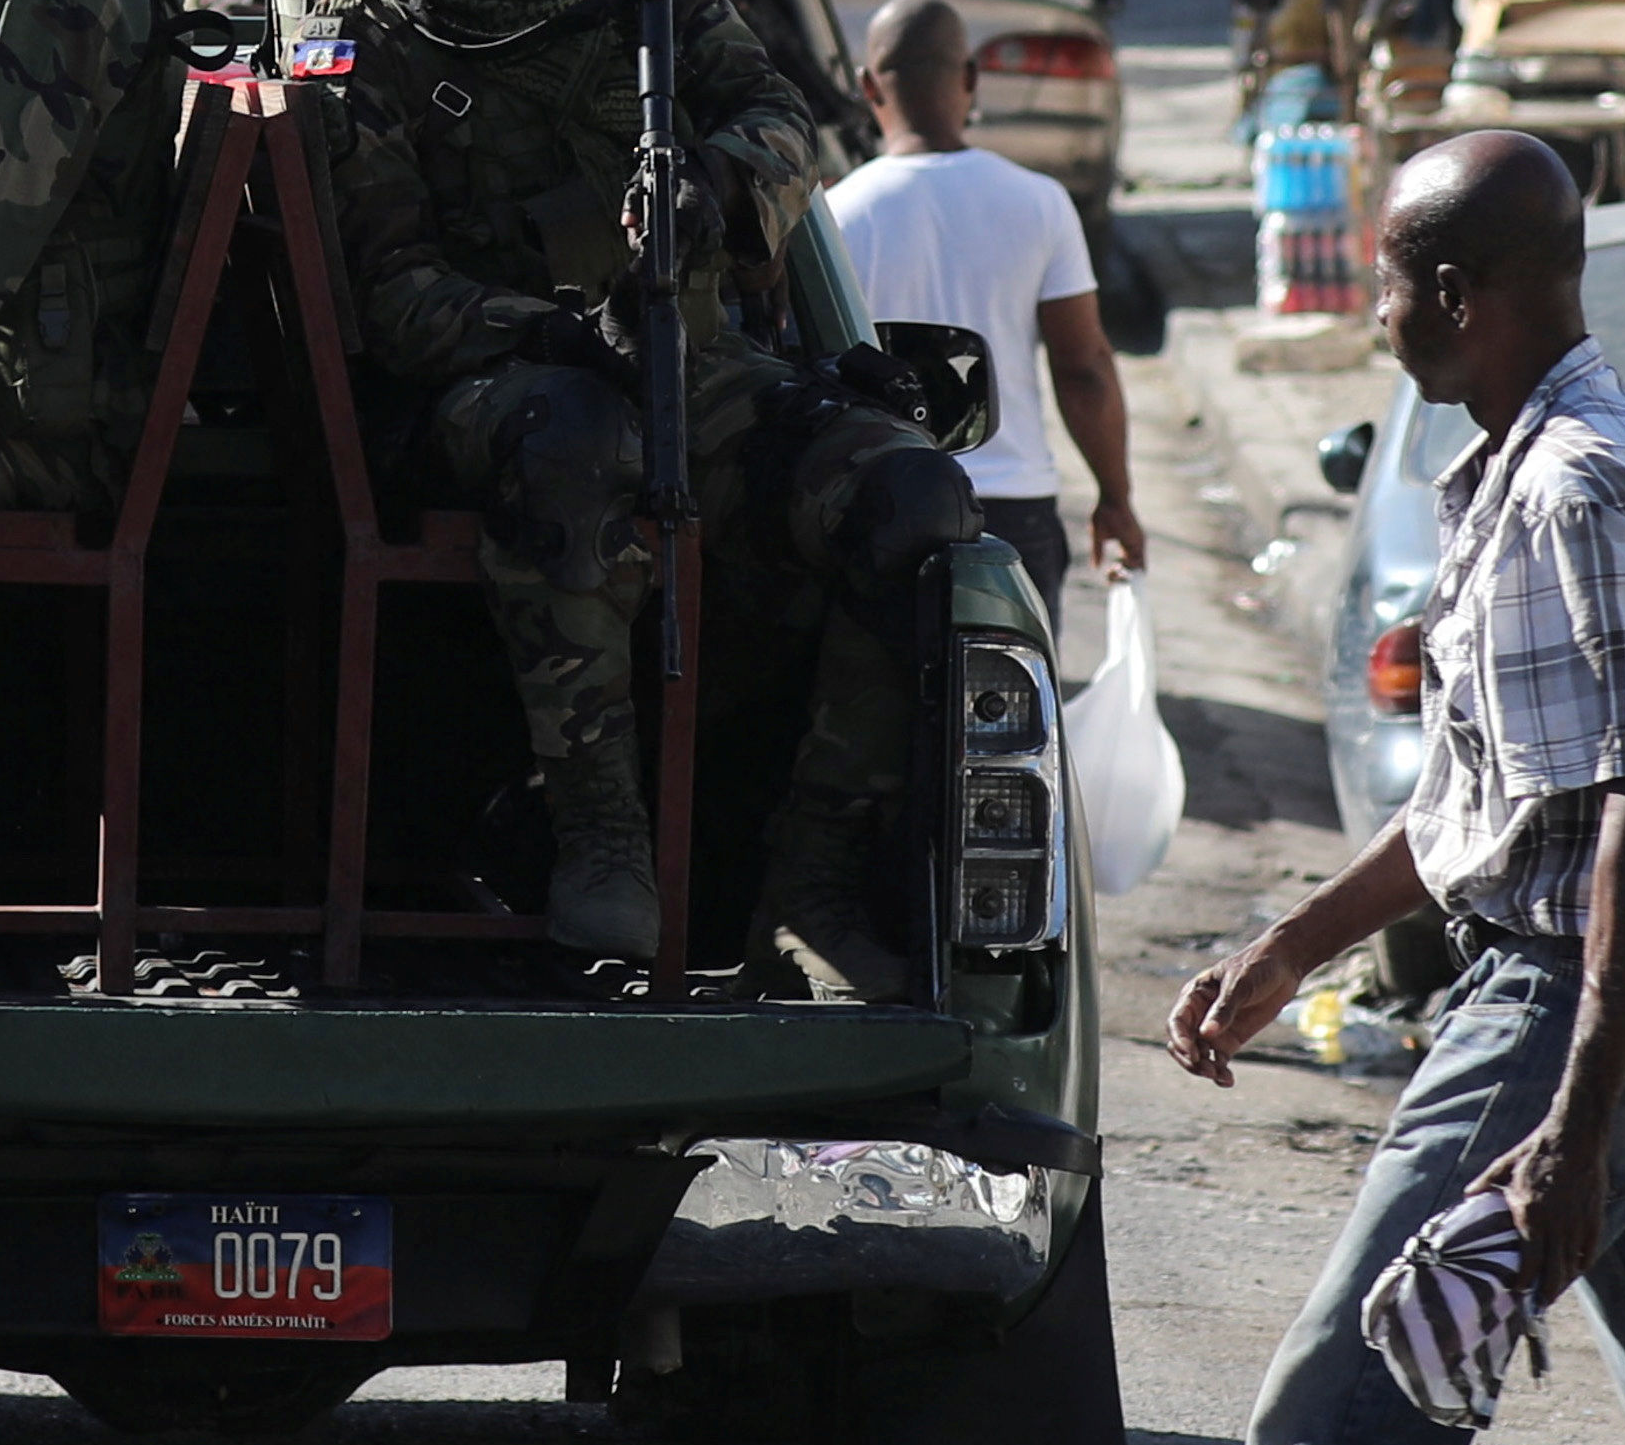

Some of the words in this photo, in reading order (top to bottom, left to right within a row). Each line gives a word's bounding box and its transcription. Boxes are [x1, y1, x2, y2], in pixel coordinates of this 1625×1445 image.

[210, 1201, 280, 1224] HAÏTI
[213, 1231, 343, 1301] 0079
[164, 1313, 216, 1327] FORCES
[219, 1311, 274, 1328] ARMÉES
